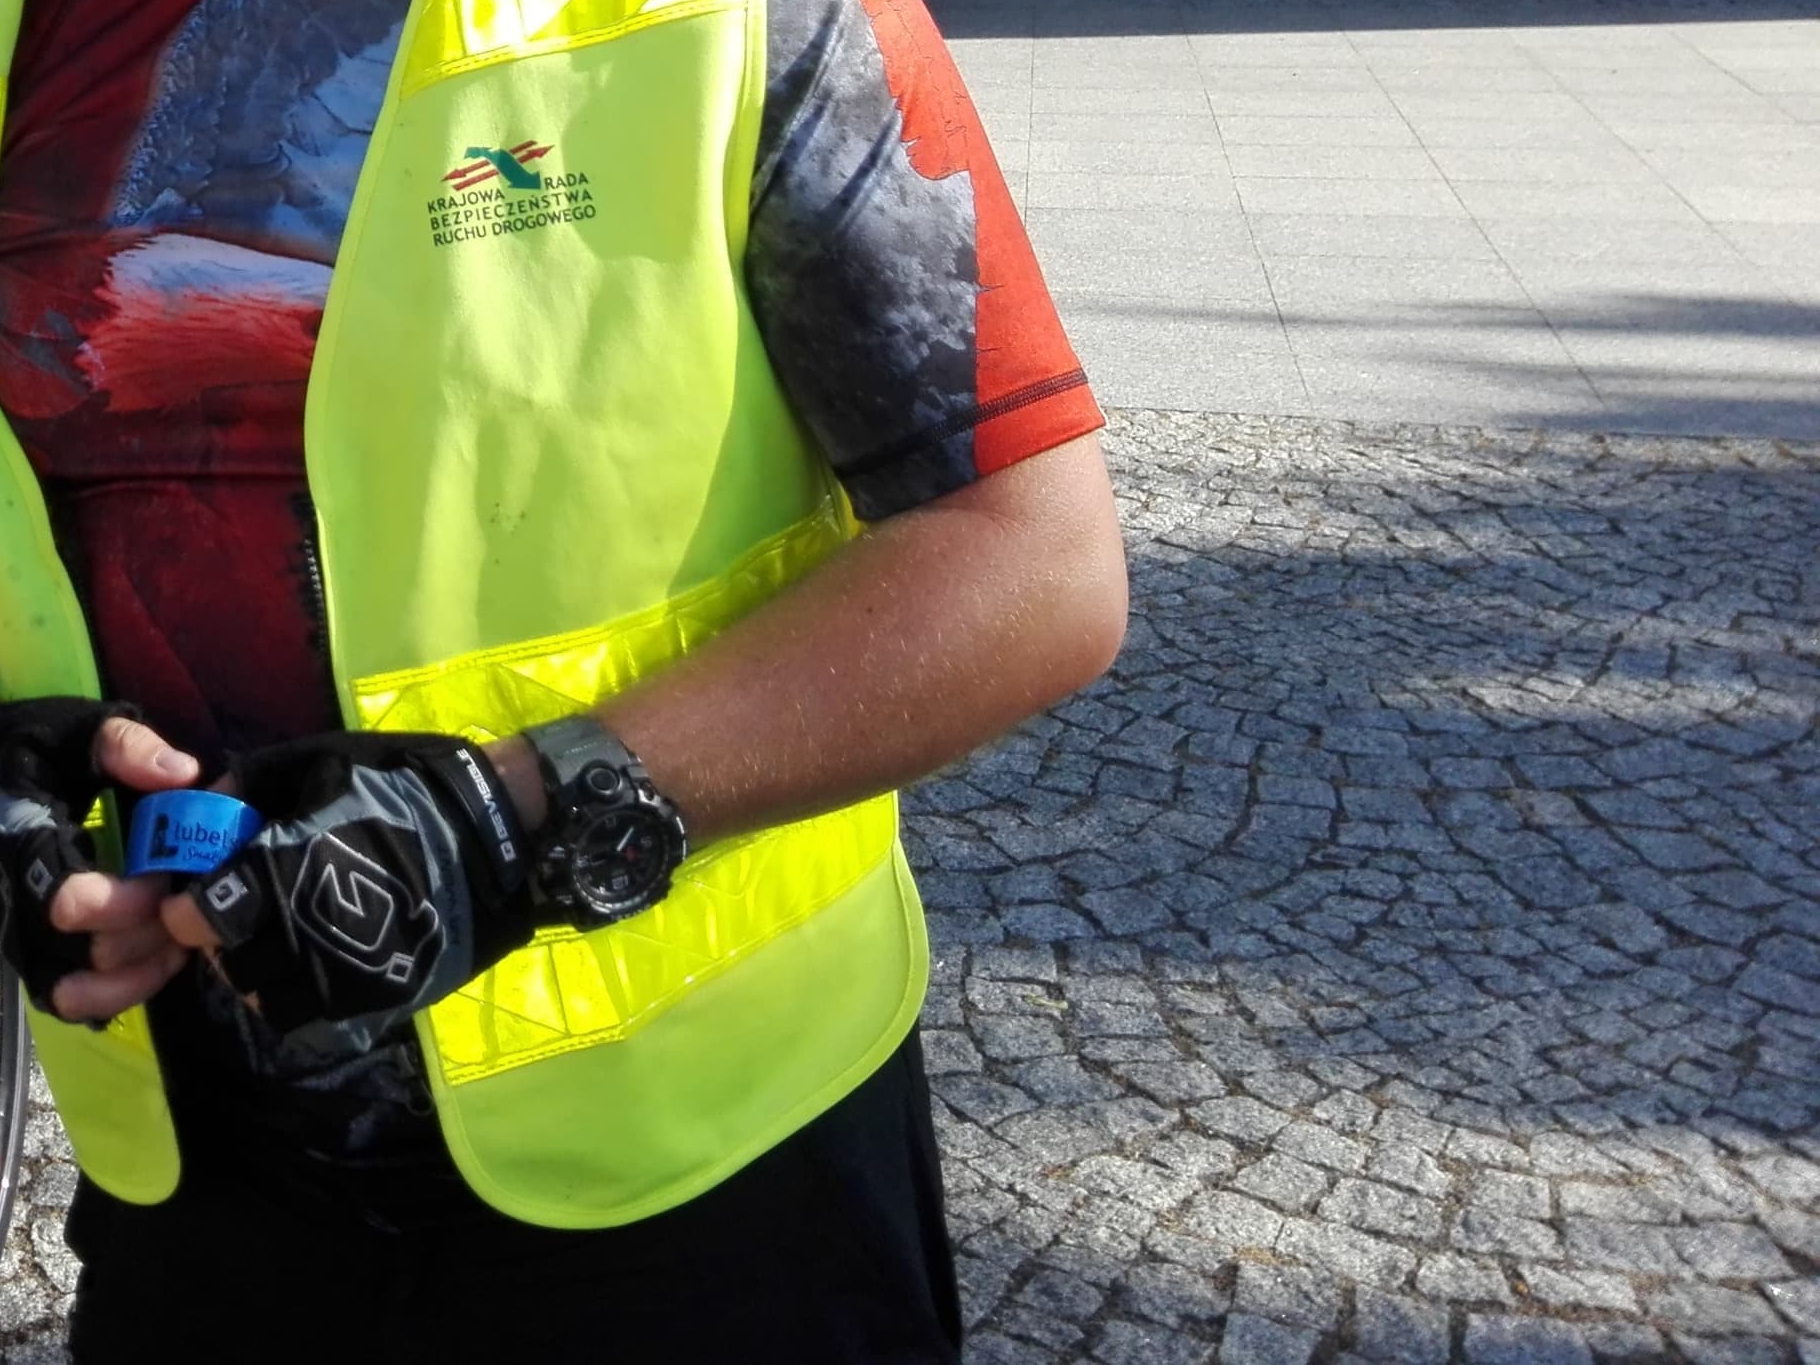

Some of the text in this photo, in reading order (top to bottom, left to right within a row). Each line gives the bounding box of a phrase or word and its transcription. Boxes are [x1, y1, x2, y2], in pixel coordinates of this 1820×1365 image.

[427, 172, 590, 214] KRAJOWA RADA
[430, 189, 593, 231] BEZPIECZEŃSTWA
[433, 205, 597, 247] RUCHU DROGOWEGO
